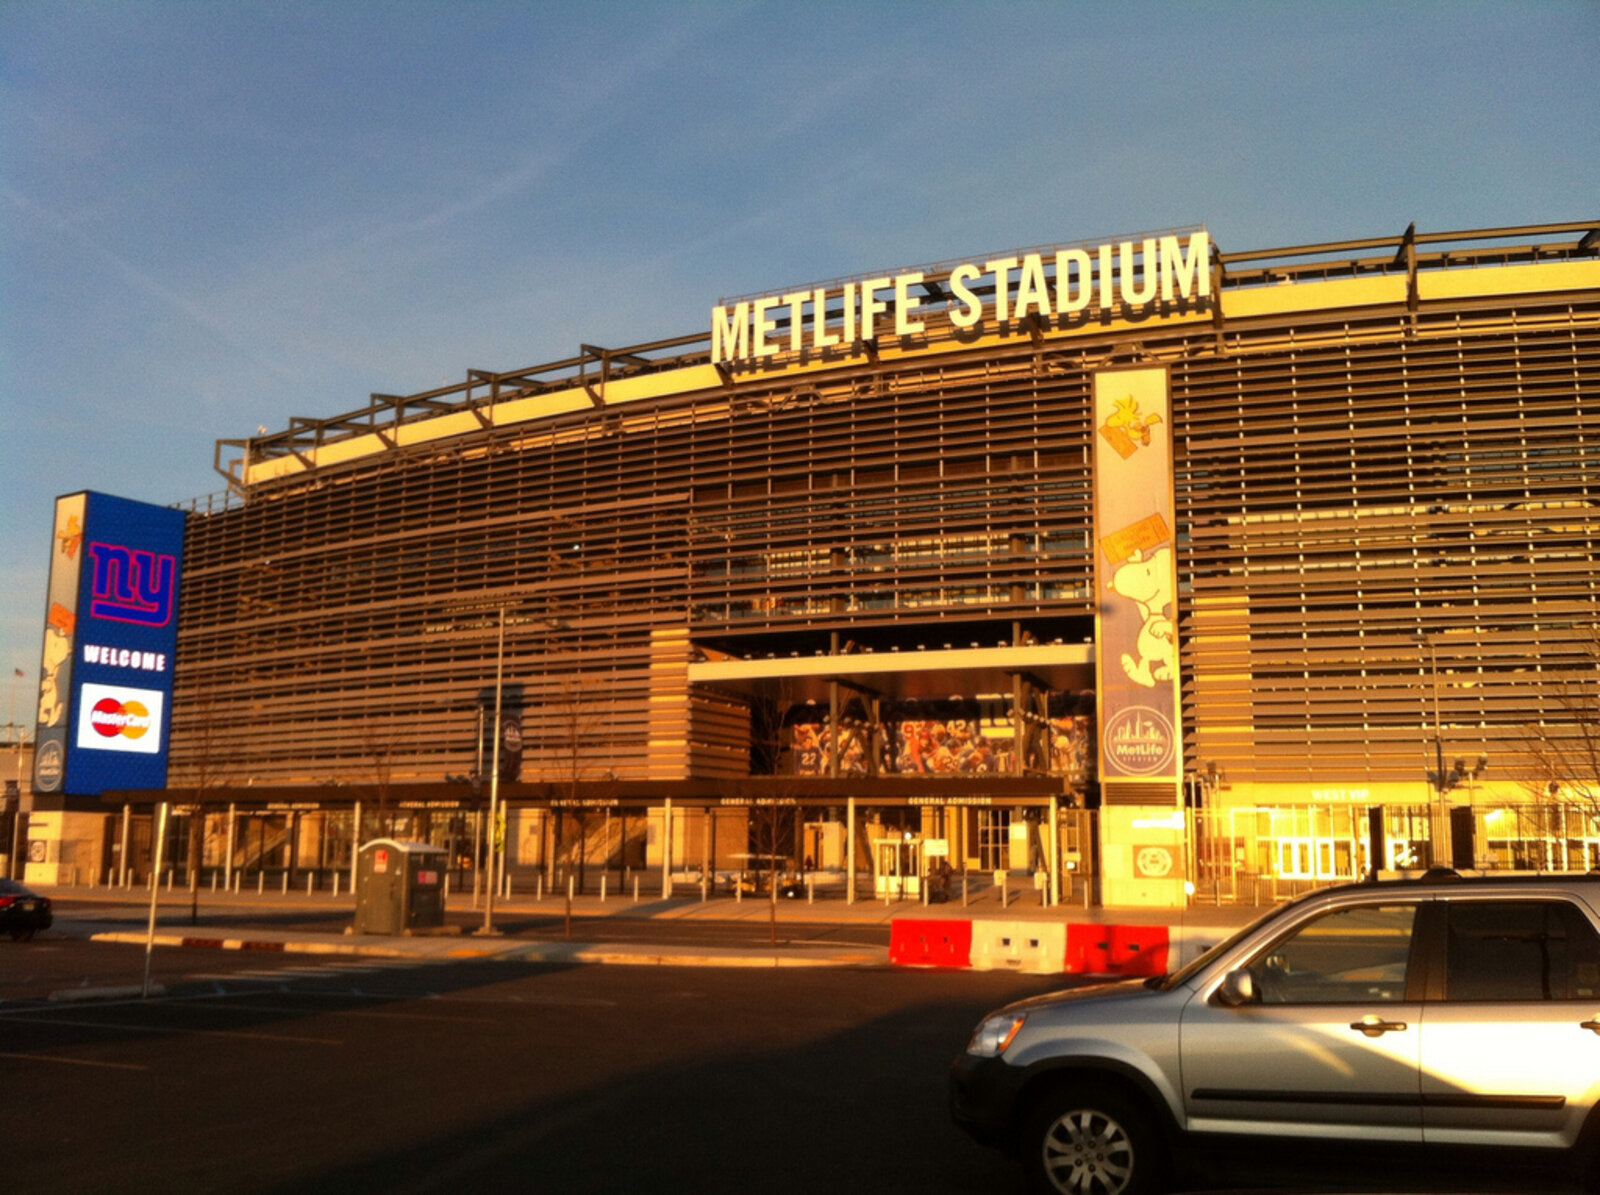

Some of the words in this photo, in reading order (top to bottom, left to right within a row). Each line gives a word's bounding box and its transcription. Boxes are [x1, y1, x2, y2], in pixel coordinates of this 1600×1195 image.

[711, 272, 925, 364] METLIFE
[948, 231, 1212, 327] STADIUM
[84, 644, 166, 672] WELCOME
[92, 710, 149, 728] MasterCard
[1116, 743, 1163, 756] MetLife
[908, 797, 945, 805] GENERAL
[947, 797, 992, 805] ADMISSION
[1311, 789, 1346, 801] WEST
[1349, 789, 1370, 801] VIP
